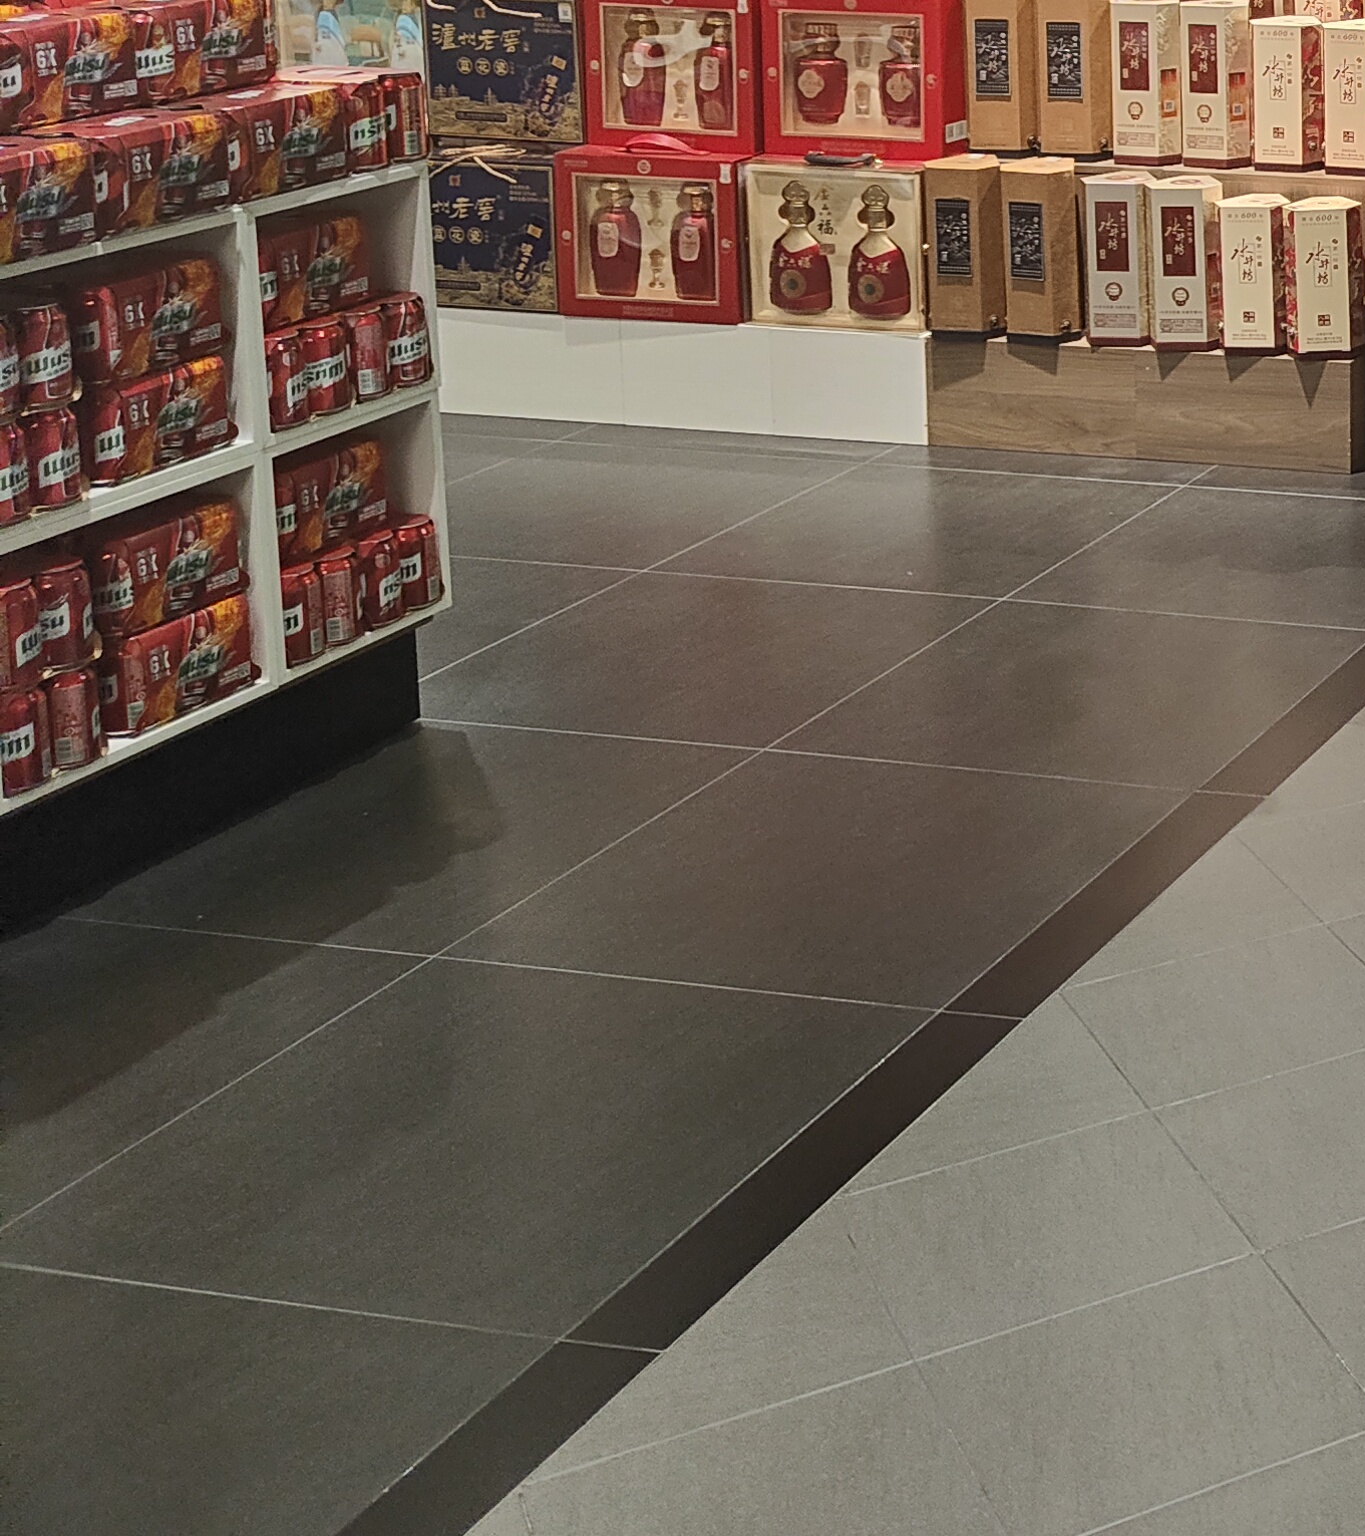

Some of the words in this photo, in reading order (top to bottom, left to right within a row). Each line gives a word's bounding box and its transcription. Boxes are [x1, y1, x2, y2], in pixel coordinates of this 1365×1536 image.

[1262, 55, 1285, 99] 水井坊
[1333, 58, 1355, 102] 水井坊
[1231, 238, 1254, 282] 水井坊
[1306, 241, 1330, 285] 水井坊
